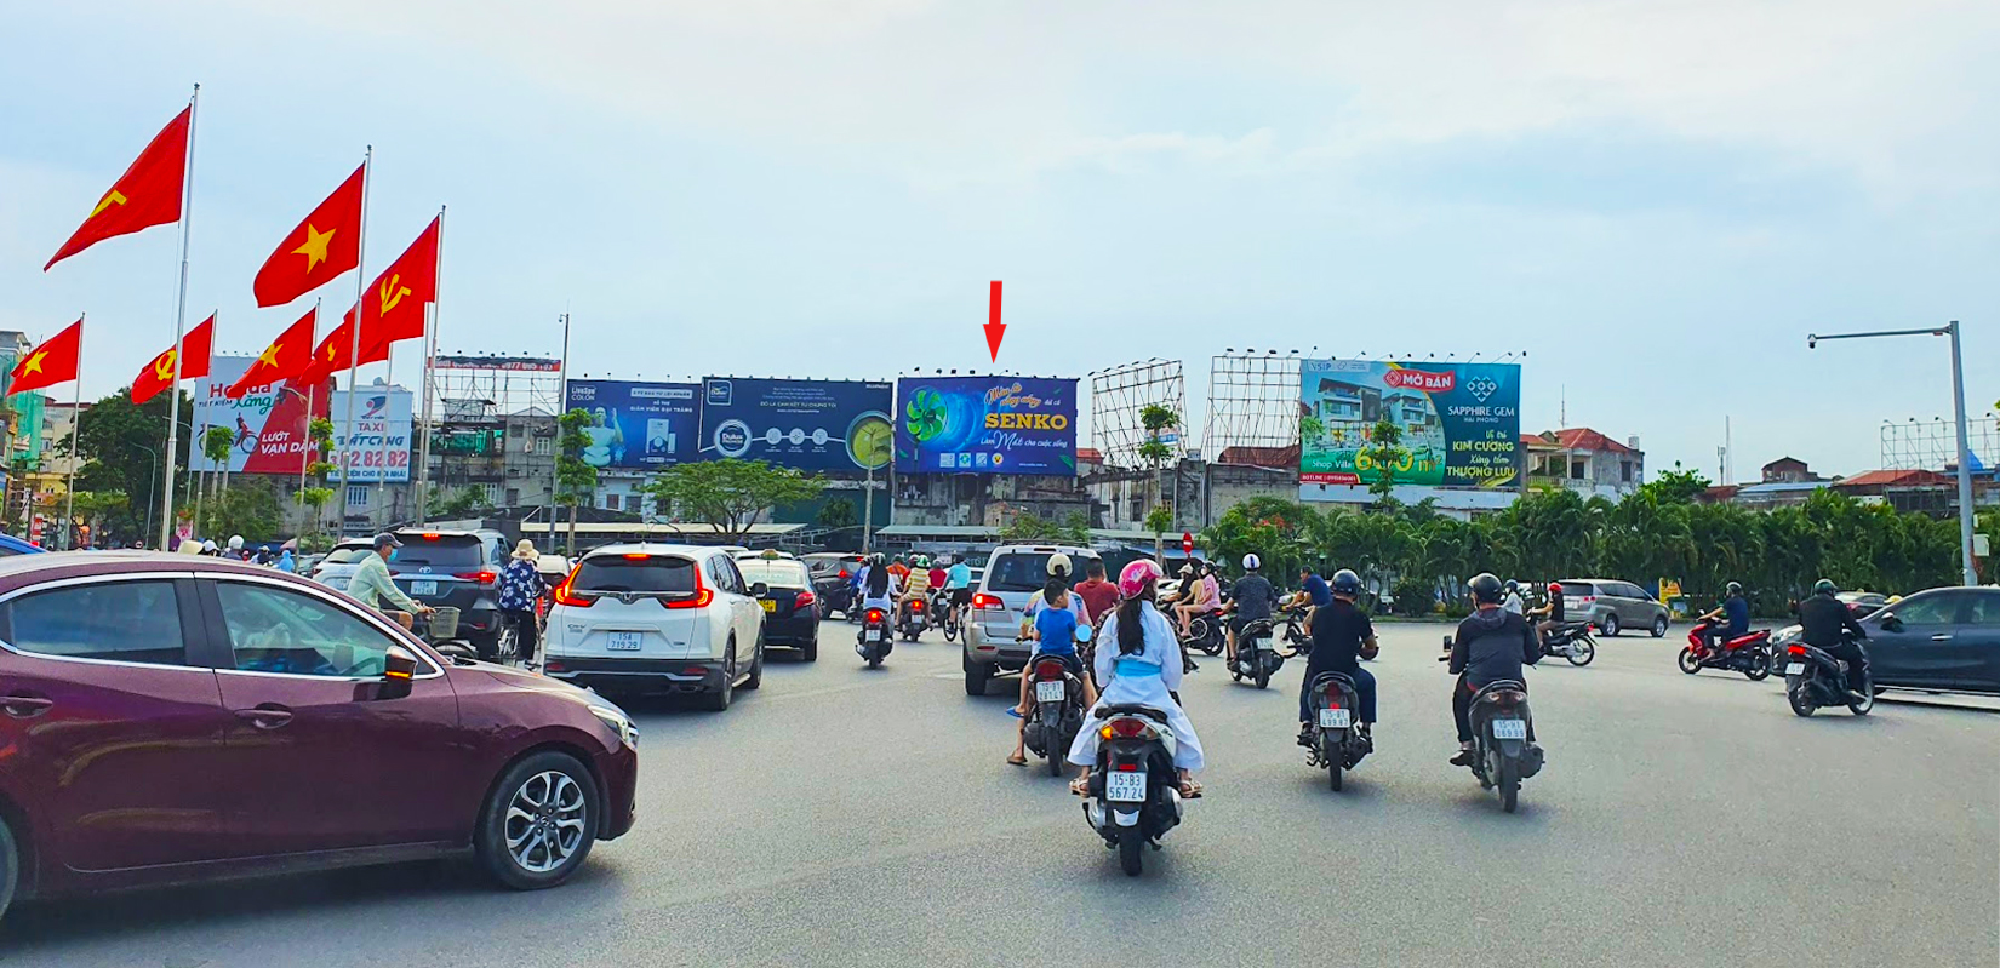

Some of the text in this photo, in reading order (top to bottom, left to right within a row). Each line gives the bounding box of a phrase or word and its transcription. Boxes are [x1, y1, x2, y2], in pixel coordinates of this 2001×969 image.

[1447, 406, 1515, 417] SAPPHIRE GEM
[359, 422, 384, 431] TAXI
[985, 412, 1068, 430] SENKO
[1452, 441, 1473, 452] KIM
[1108, 788, 1143, 799] 567.24
